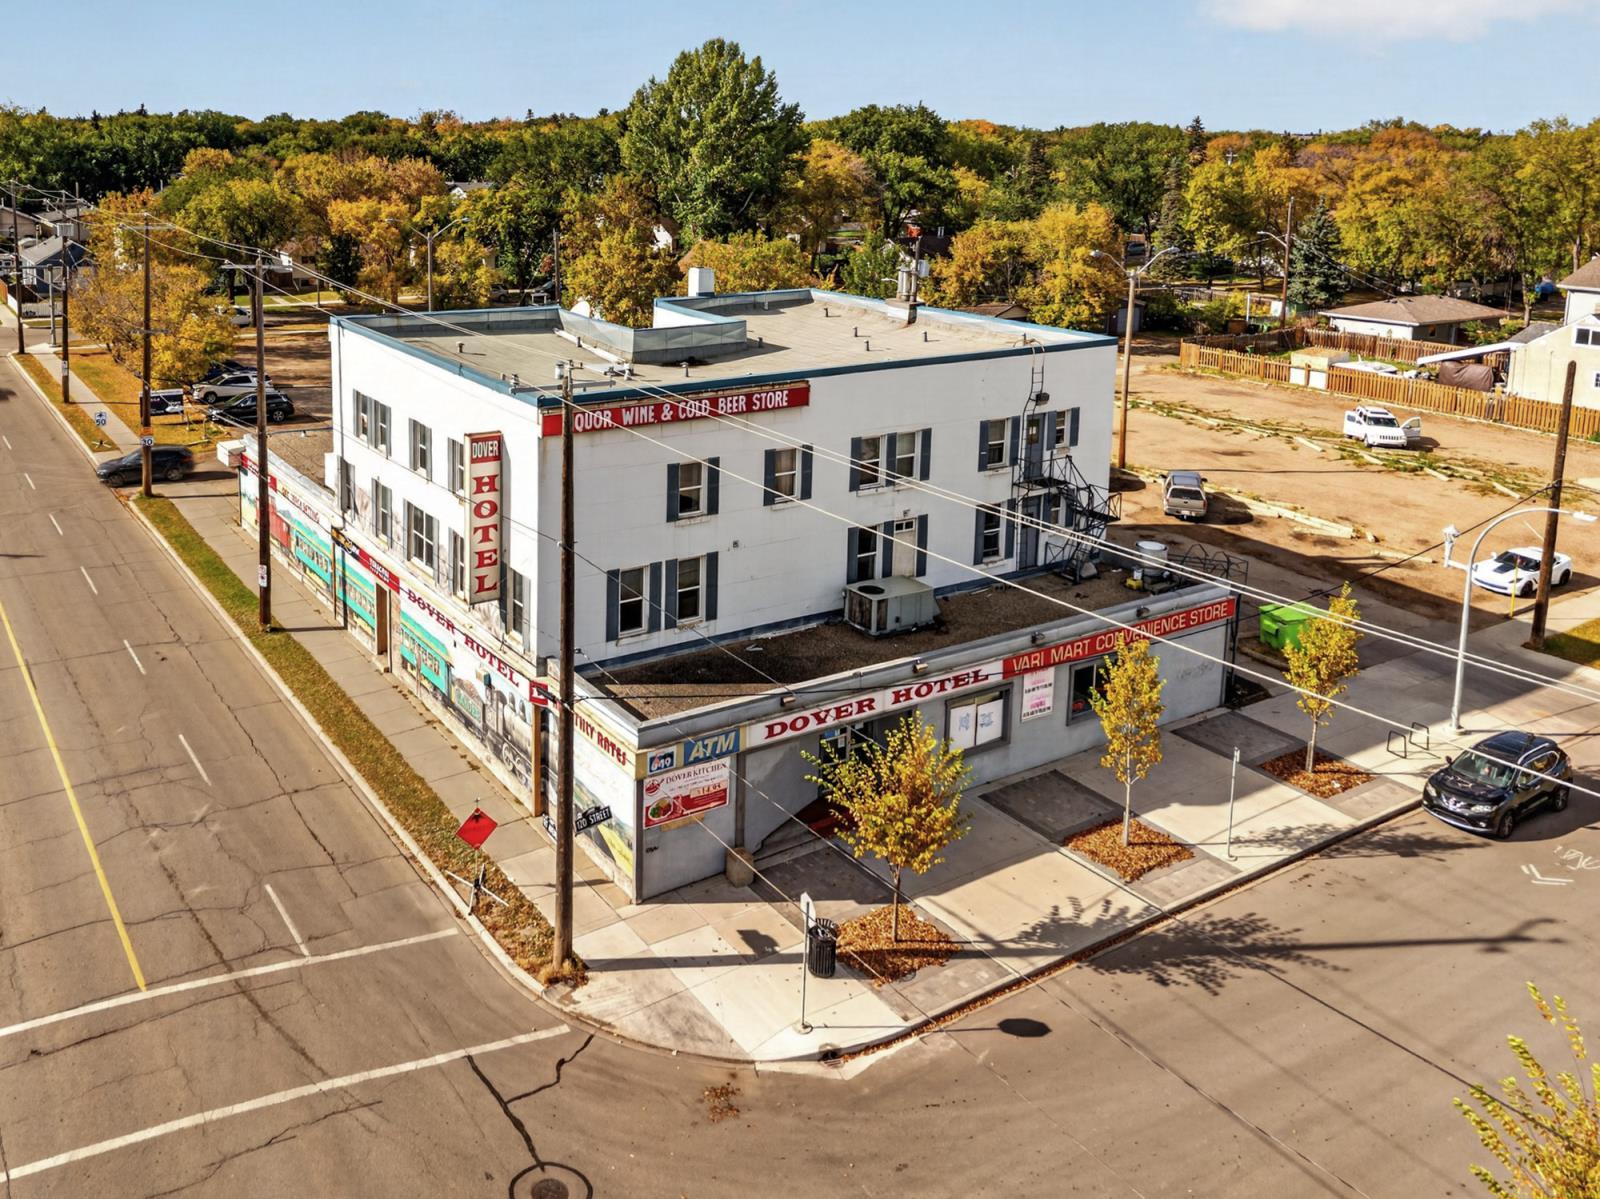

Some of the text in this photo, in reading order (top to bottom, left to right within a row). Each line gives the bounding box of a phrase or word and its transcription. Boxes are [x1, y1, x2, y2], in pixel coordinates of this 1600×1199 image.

[661, 403, 673, 421] &
[678, 400, 710, 420] COLD
[718, 395, 746, 415] BEER
[752, 390, 789, 410] STORE
[472, 440, 499, 458] DOVER
[472, 474, 499, 594] HOTEL
[406, 589, 519, 688] DOVER HOTEL
[1012, 653, 1045, 673] VARI
[1050, 639, 1091, 664] MART
[1190, 602, 1228, 625] STORE
[764, 669, 989, 740] DOVER HOTEL
[688, 731, 736, 761] ATM
[589, 809, 610, 825] STREET
